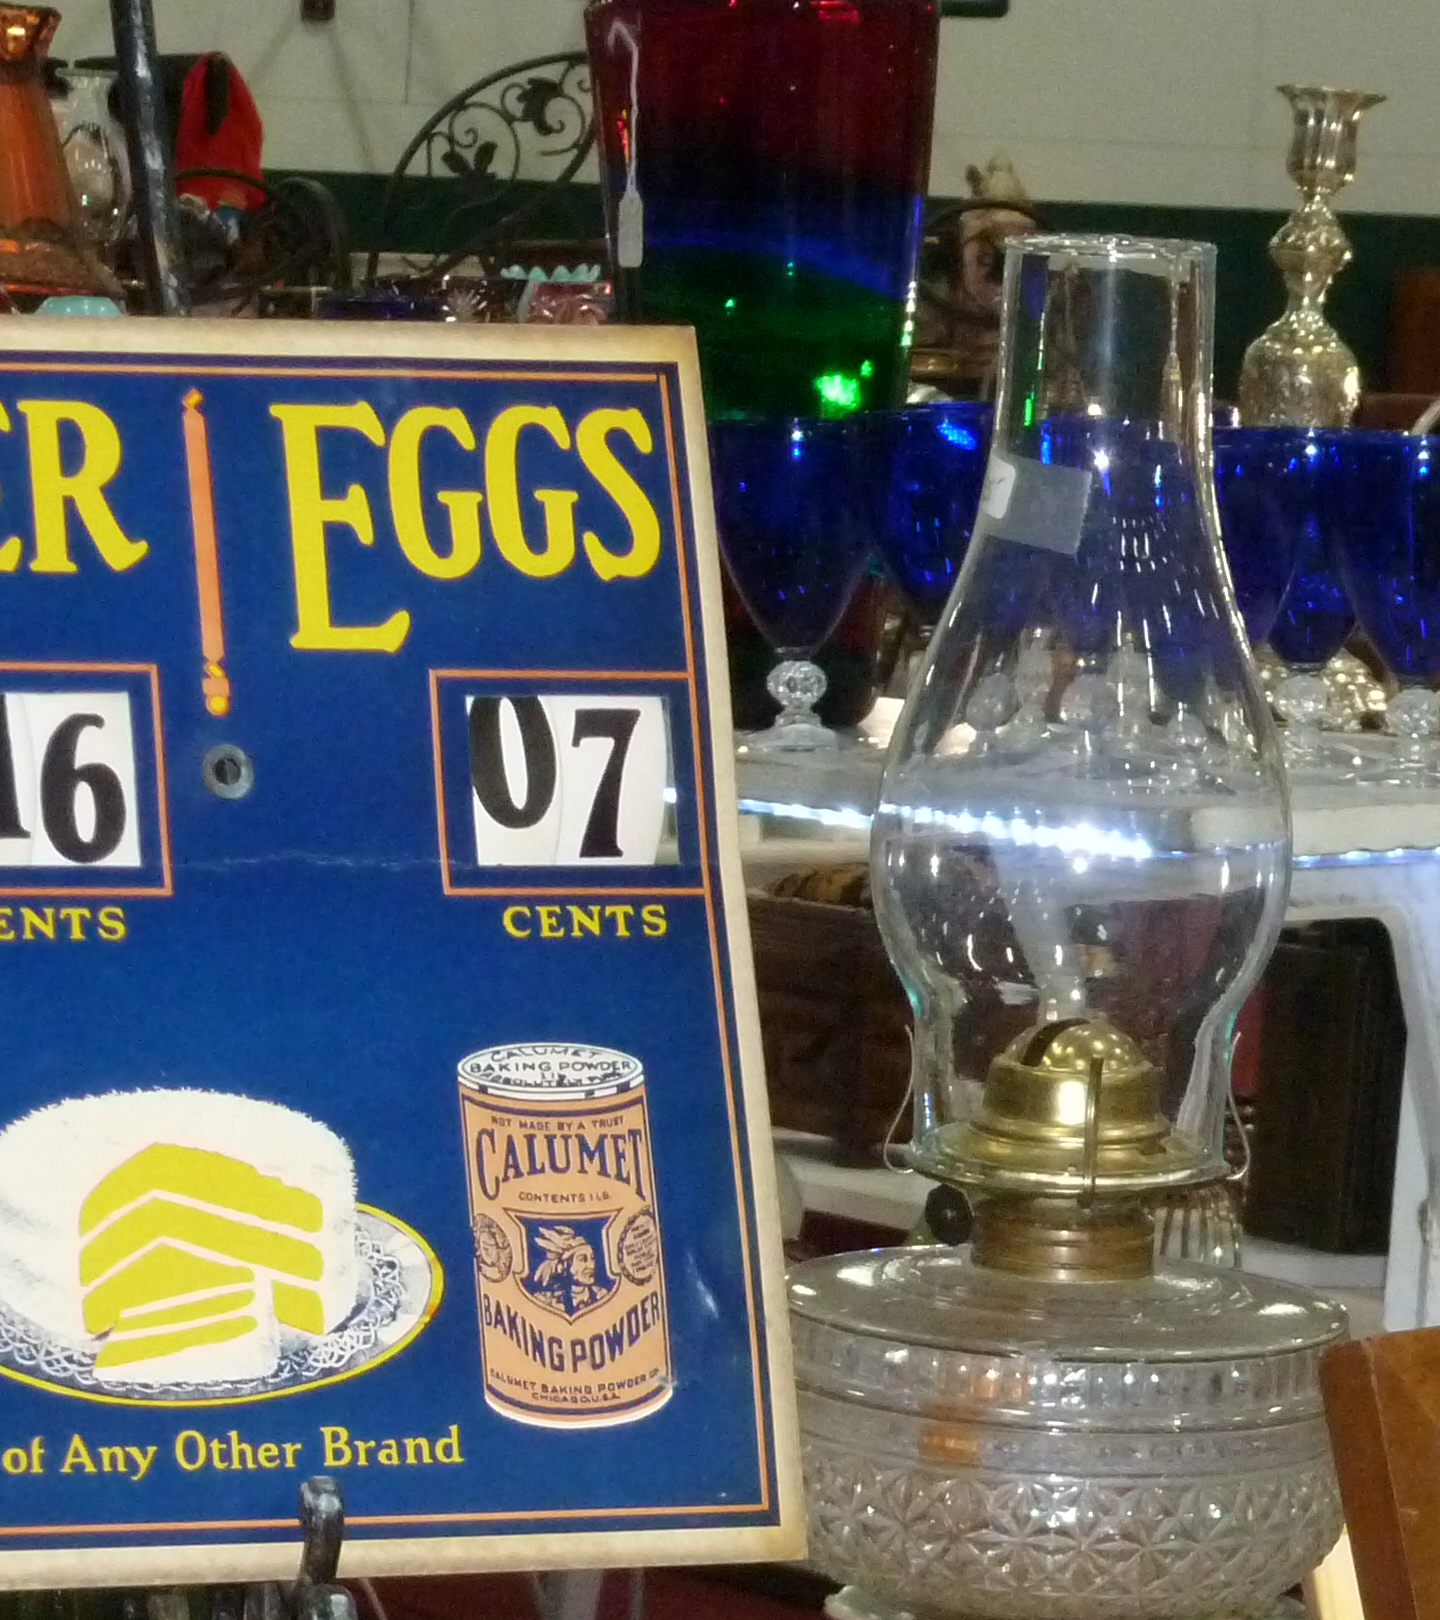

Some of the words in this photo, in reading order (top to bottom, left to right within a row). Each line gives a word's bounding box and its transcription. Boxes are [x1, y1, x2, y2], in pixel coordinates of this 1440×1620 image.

[269, 400, 660, 653] EGGS
[468, 696, 641, 859] 07
[503, 904, 668, 938] CENTS
[469, 1061, 552, 1073] BAKING
[559, 1060, 632, 1072] POWDER
[490, 1046, 603, 1062] CALUMET
[491, 1115, 511, 1127] NOT
[519, 1120, 551, 1131] MADE
[557, 1121, 574, 1131] BY
[576, 1120, 586, 1130] A
[592, 1115, 625, 1128] TRUST
[476, 1128, 647, 1201] CALUMET
[518, 1191, 585, 1204] CONTENTS
[483, 1293, 565, 1373] BAKING
[570, 1290, 660, 1373] POWDER
[490, 1367, 536, 1392] CALUMET
[541, 1383, 593, 1395] BAKING
[597, 1375, 647, 1392] POWDER
[3, 1436, 44, 1474] of
[60, 1433, 157, 1481] Any
[174, 1429, 301, 1472] Other
[319, 1425, 465, 1469] Brand
